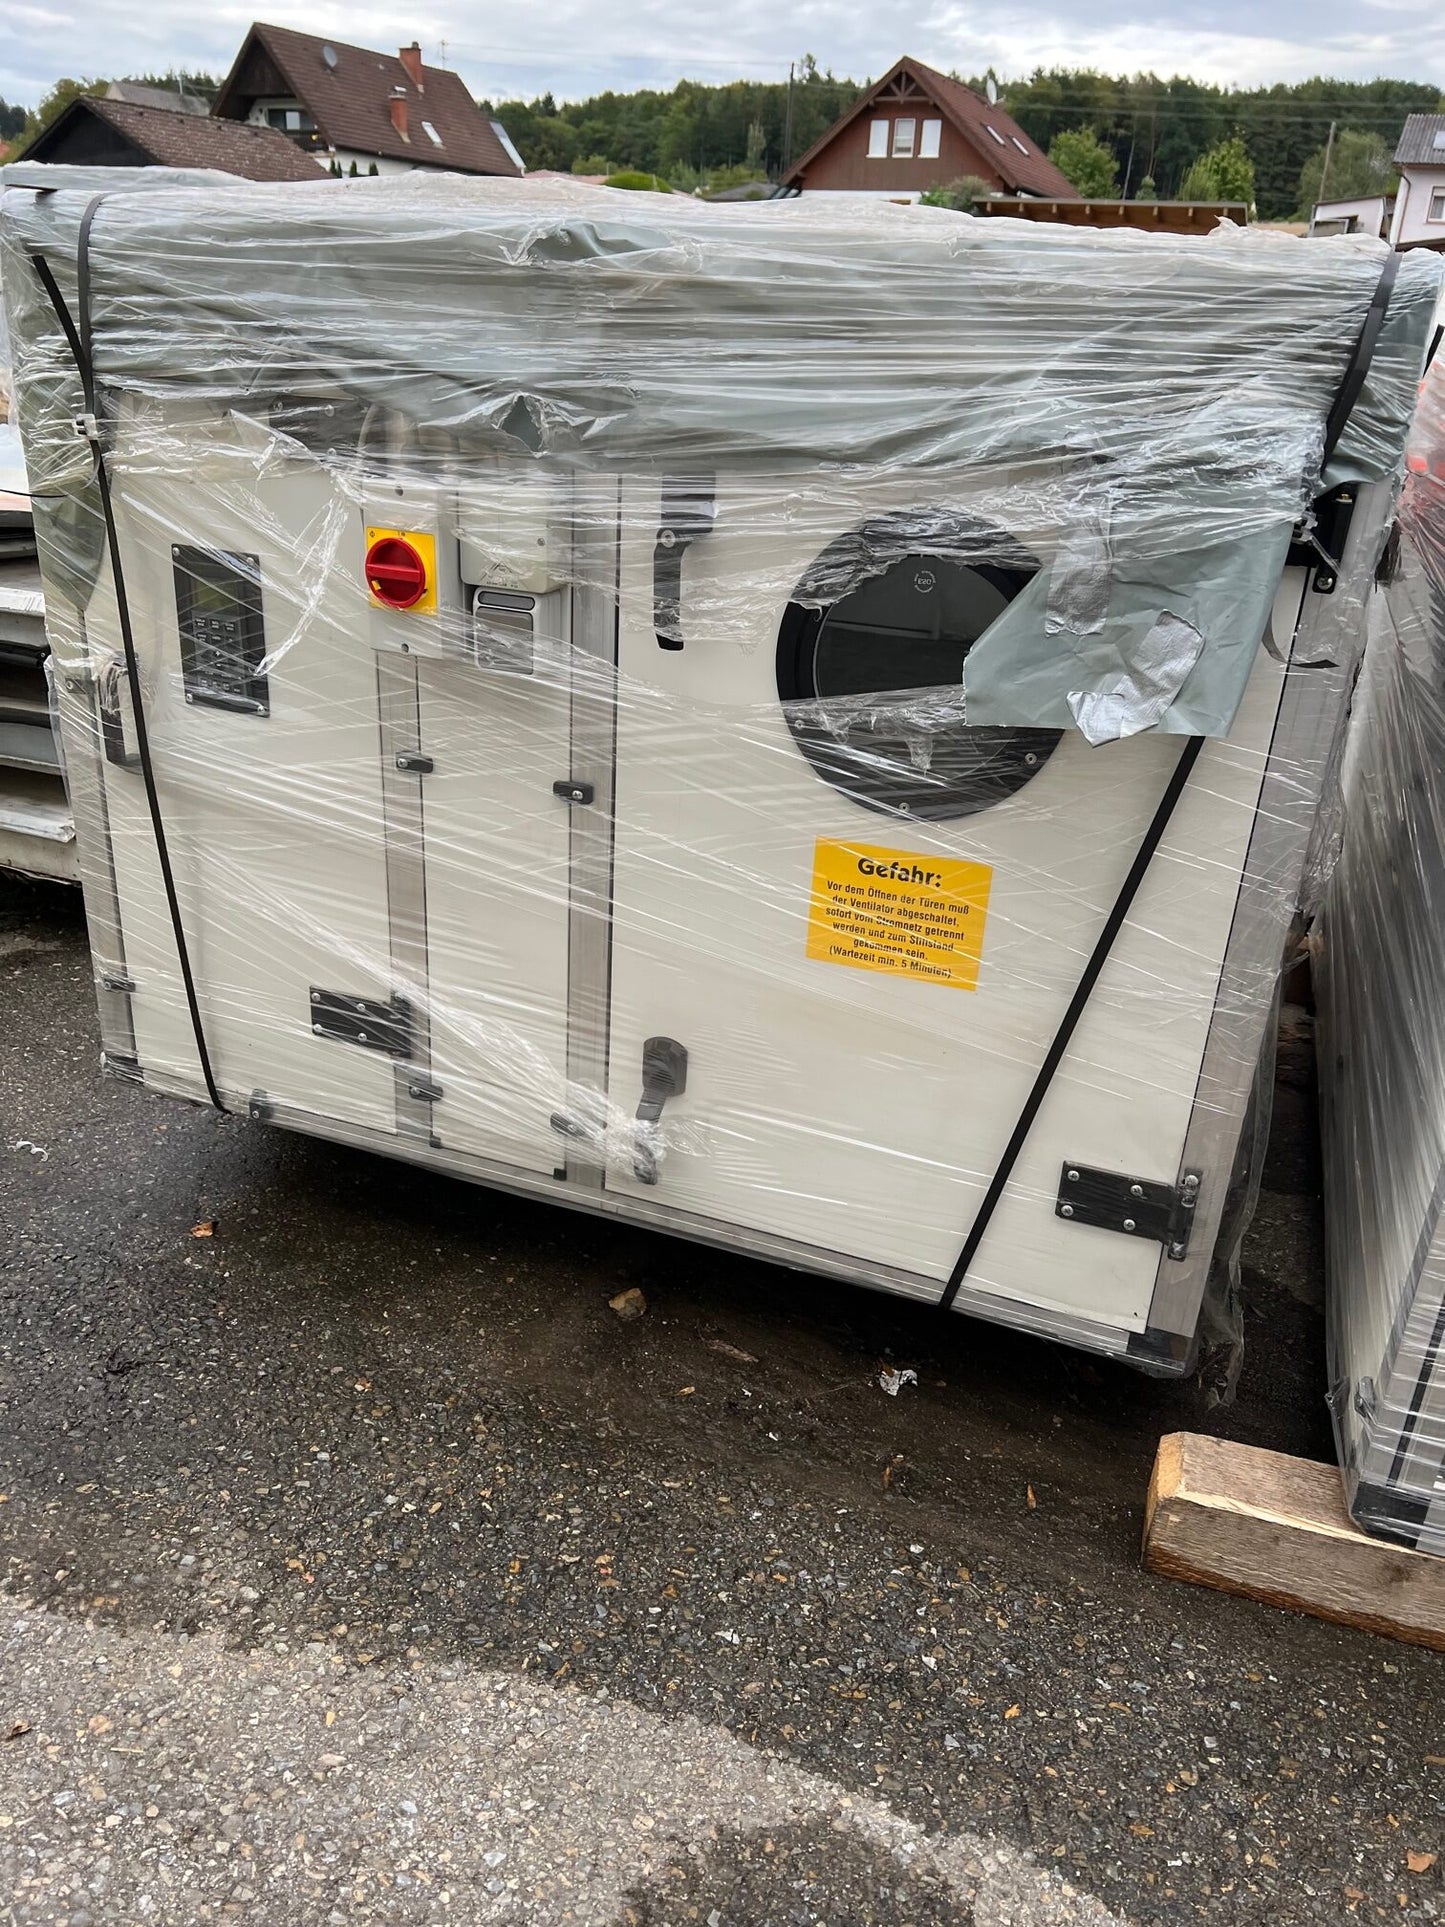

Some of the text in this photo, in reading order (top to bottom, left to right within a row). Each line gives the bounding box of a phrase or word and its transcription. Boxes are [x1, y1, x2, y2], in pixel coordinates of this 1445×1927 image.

[858, 857, 942, 888] Gefahr:
[827, 880, 970, 915] Vor dem Öffnen der Türen muß
[832, 895, 847, 905] der
[850, 898, 894, 915] Ventilator
[825, 907, 965, 941] sofort vom Stromnetz getrennt
[833, 921, 954, 952] werden und zum Stillstand
[829, 945, 953, 979] (Wartezeit min. 5 Minuten)
[853, 938, 928, 960] gekommen sein.
